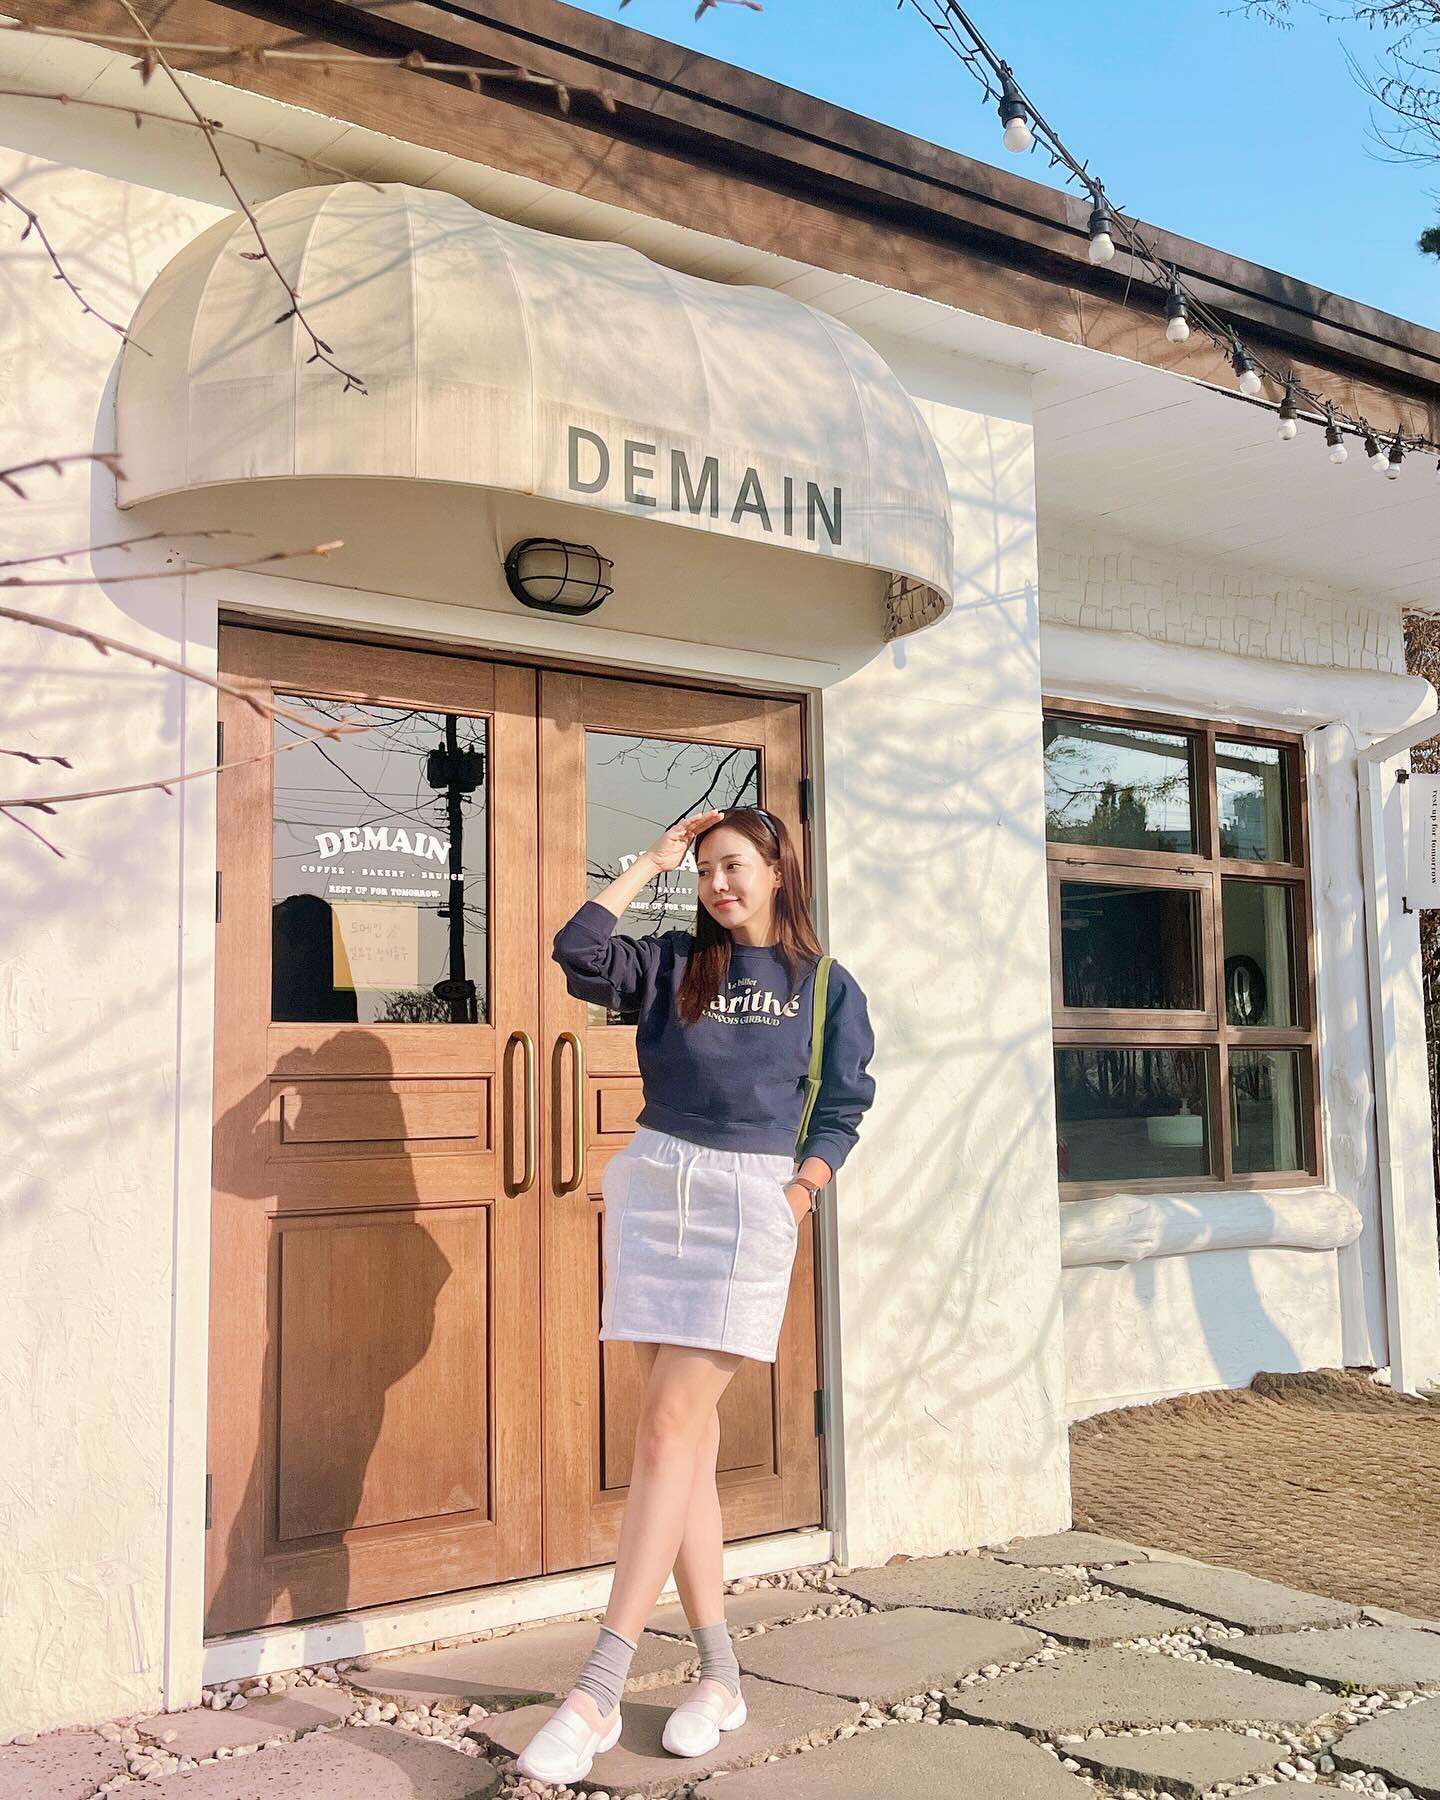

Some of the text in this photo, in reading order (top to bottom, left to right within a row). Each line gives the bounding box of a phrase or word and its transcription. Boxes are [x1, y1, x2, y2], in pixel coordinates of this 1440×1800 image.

[568, 425, 842, 546] DEMAIN
[1430, 810, 1438, 821] up
[1431, 824, 1439, 837] for
[314, 826, 452, 864] DEMAIN
[301, 865, 464, 881] COFFEE BAKERY BRUNCH
[329, 885, 352, 893] REST
[355, 886, 368, 895] UP
[370, 886, 388, 896] FOR
[710, 988, 800, 1017] arithé
[739, 1015, 780, 1026] GIRBAUD
